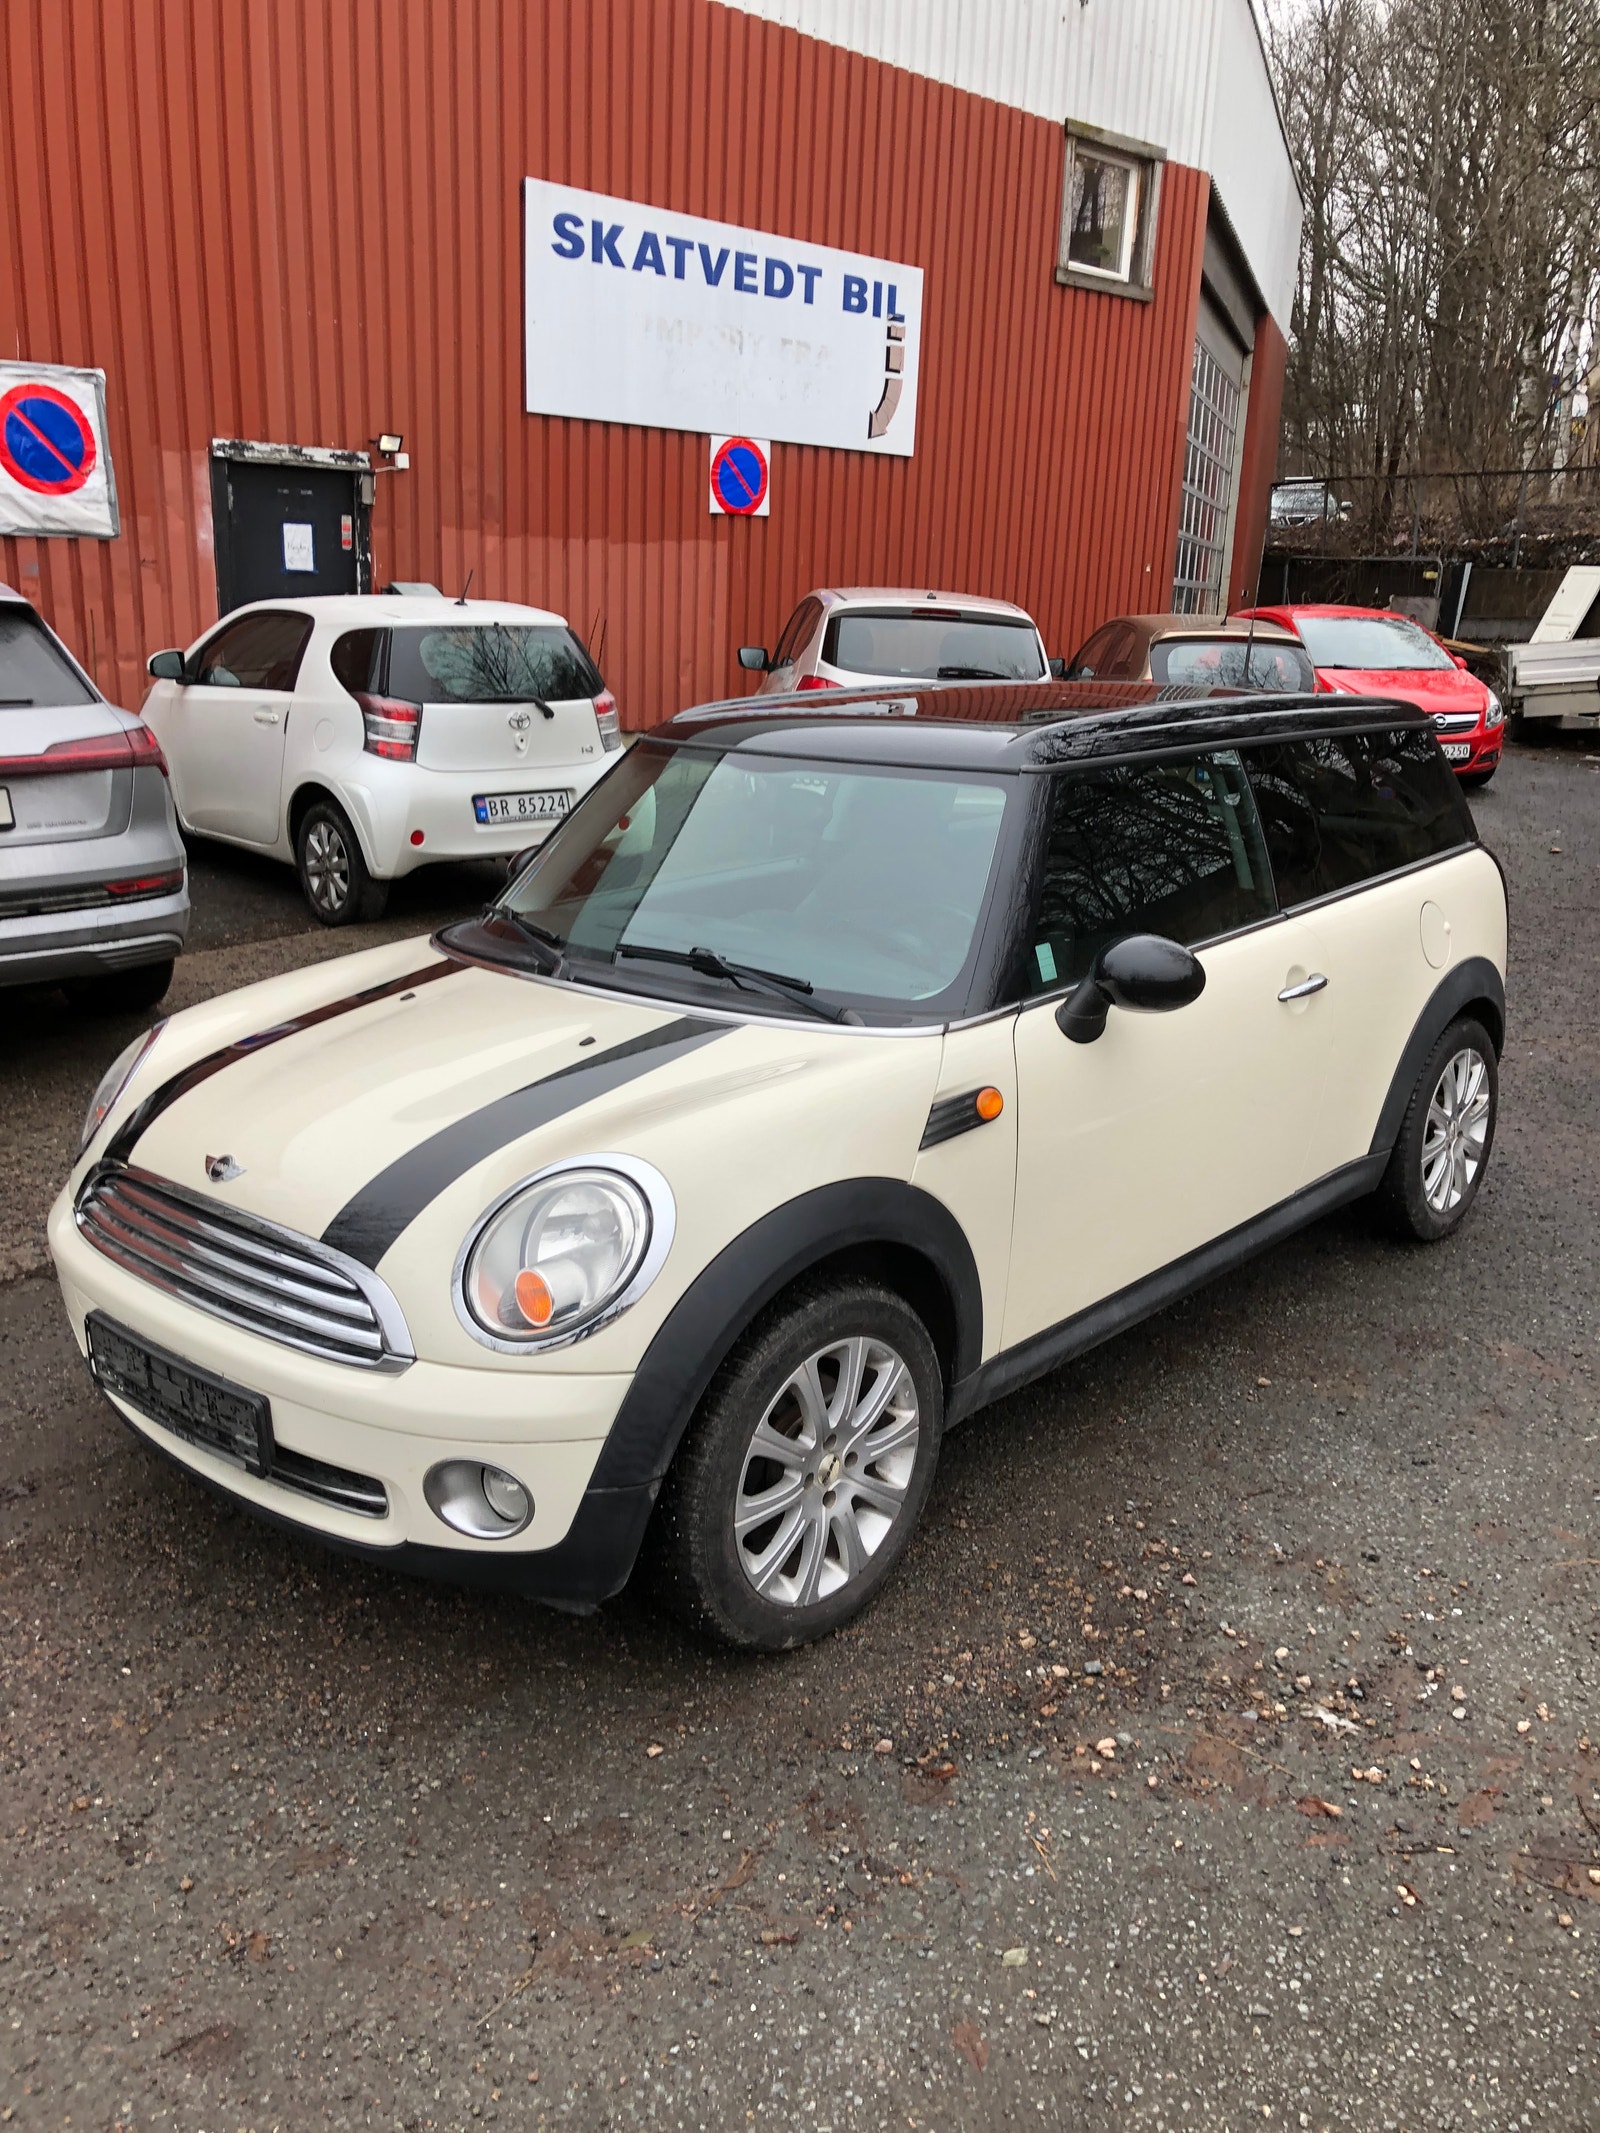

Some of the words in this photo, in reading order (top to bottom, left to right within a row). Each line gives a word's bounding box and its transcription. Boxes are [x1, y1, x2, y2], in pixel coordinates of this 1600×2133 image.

[551, 213, 823, 305] SKATVEDT
[842, 273, 905, 323] BIL
[488, 799, 510, 817] BR
[518, 794, 565, 814] 85224
